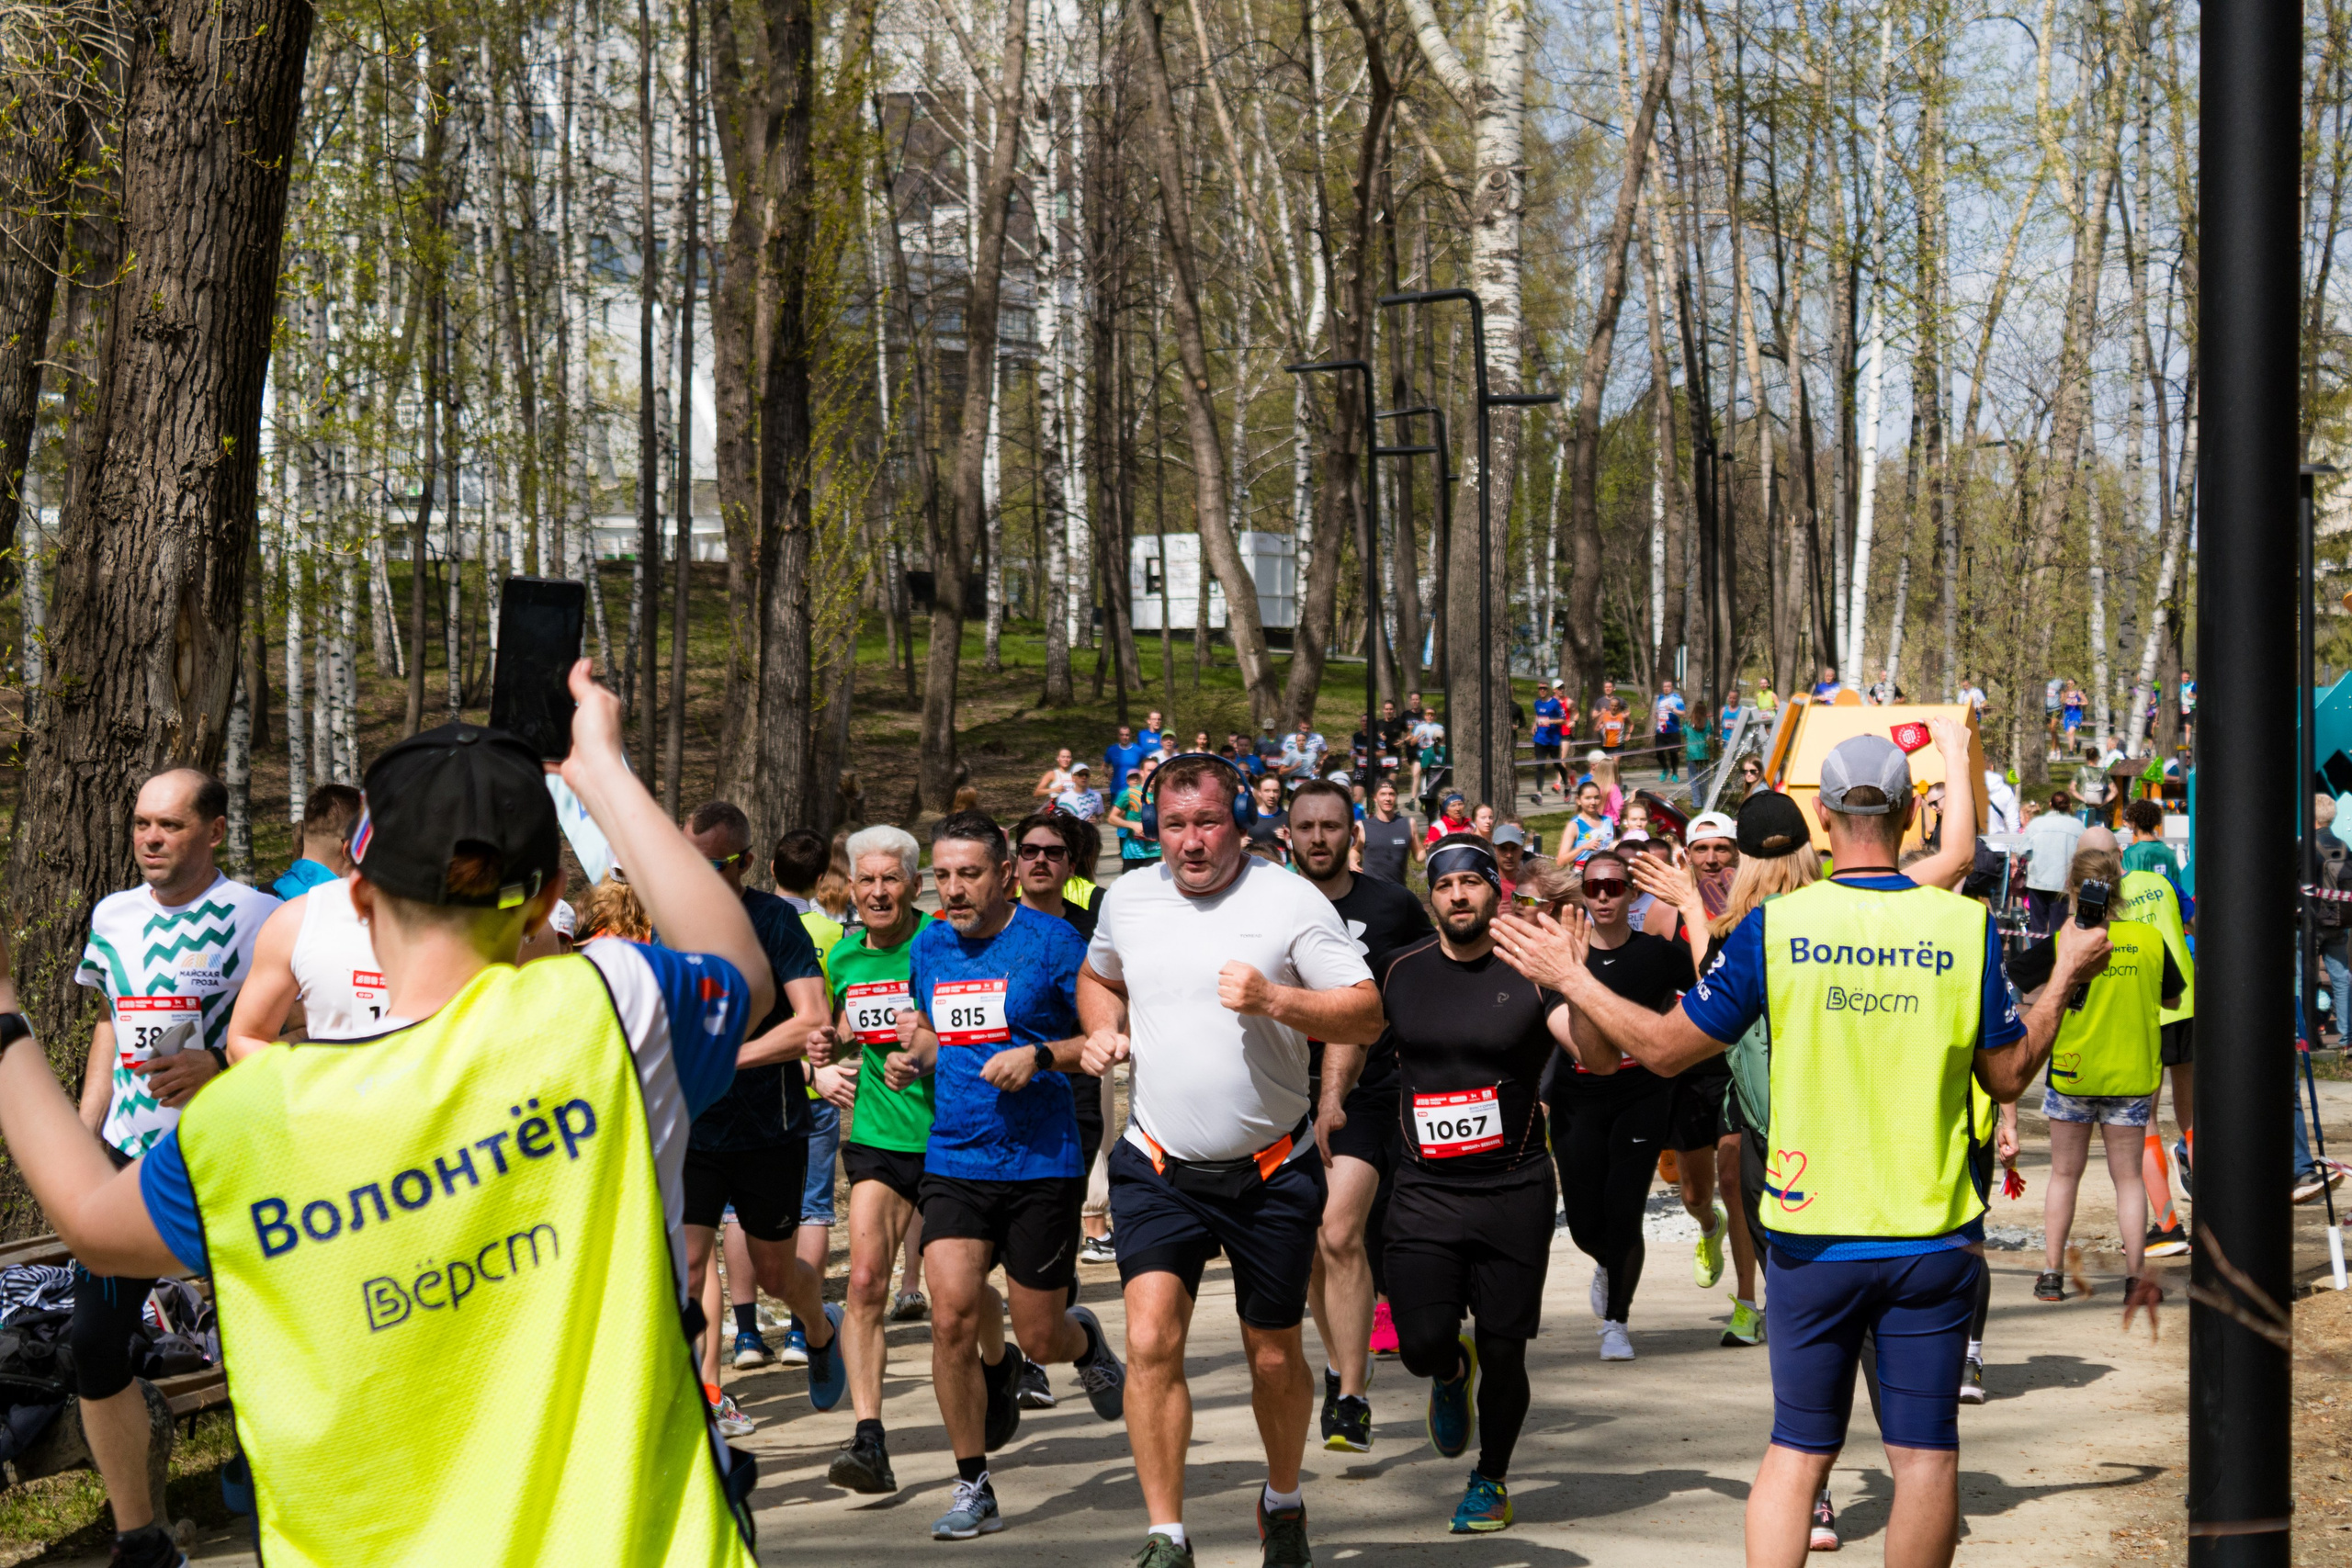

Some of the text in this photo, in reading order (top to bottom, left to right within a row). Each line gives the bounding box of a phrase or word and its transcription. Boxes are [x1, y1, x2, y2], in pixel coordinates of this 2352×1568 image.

[1628, 913, 1645, 922] RLD
[1790, 937, 1954, 976] Волонтёр
[179, 969, 220, 977] МАЙСКАЯ
[951, 1007, 985, 1028] 815
[134, 1026, 175, 1049] 38
[1426, 1115, 1487, 1141] 1067
[250, 1098, 597, 1259] Волонтёр
